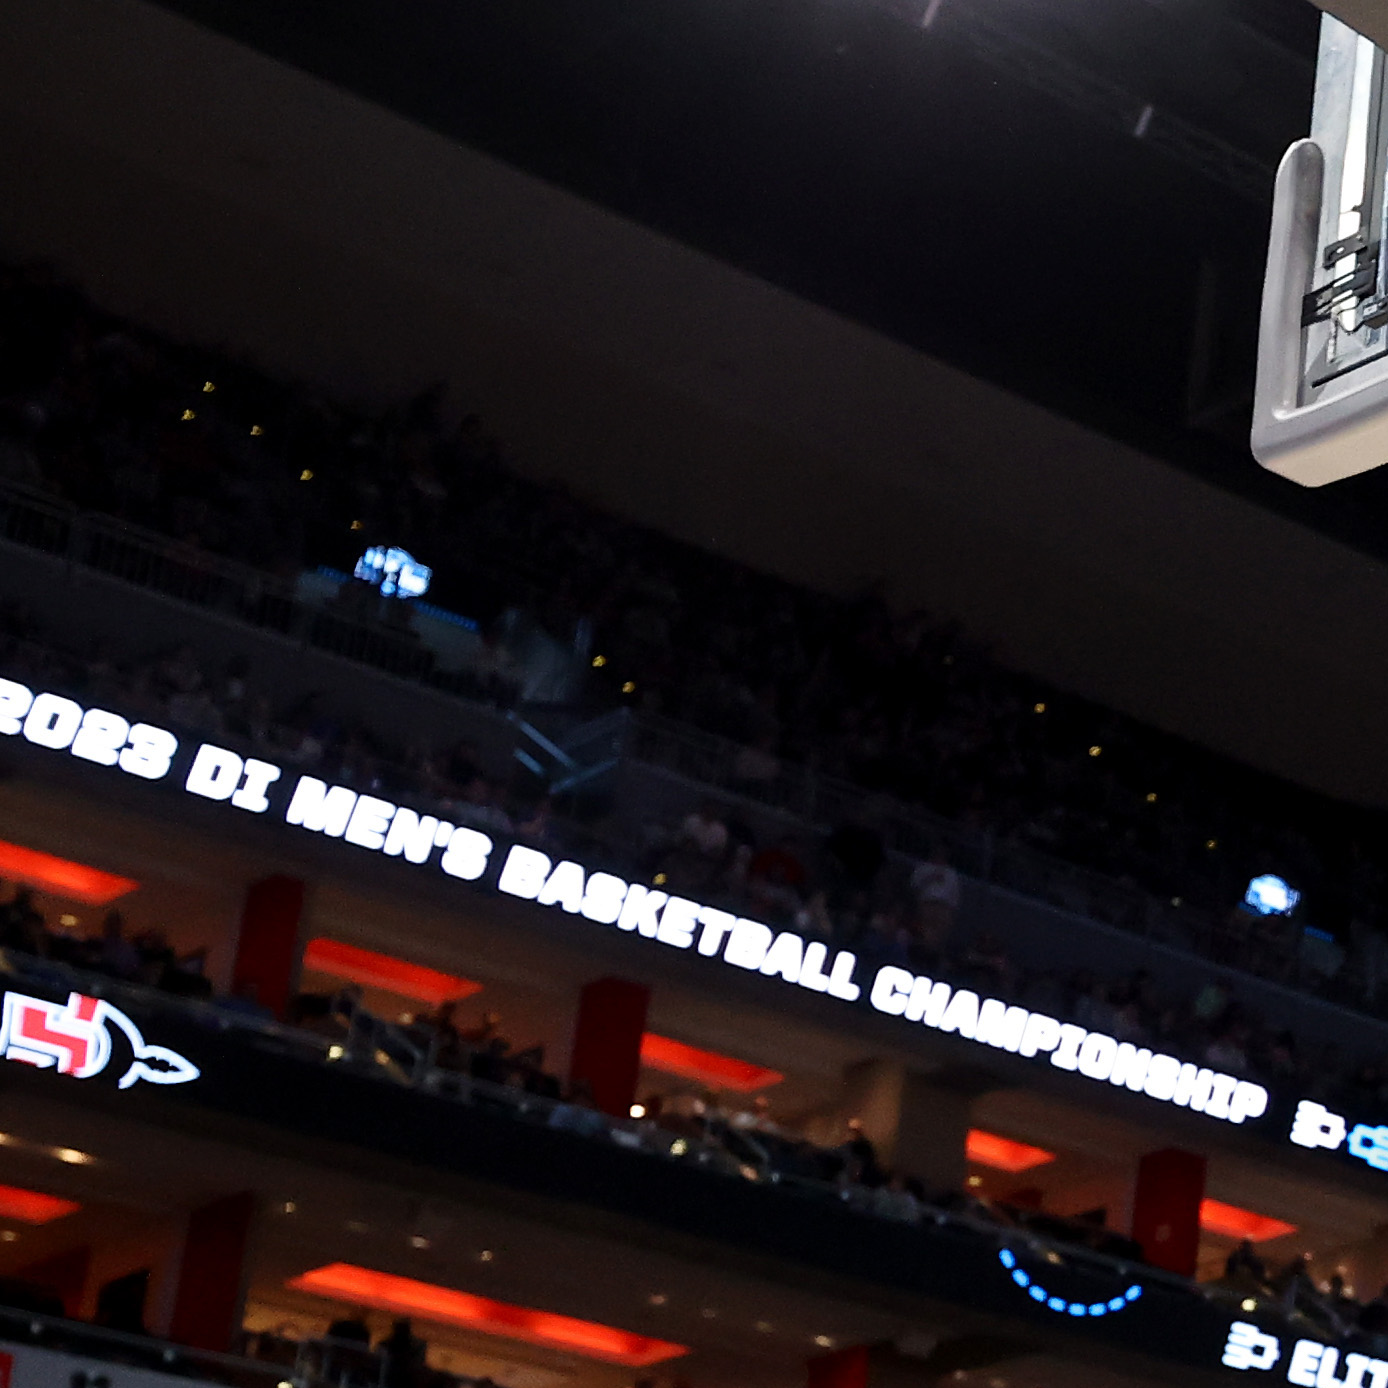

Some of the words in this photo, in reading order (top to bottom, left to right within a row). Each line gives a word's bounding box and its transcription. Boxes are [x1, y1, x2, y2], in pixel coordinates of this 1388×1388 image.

[285, 775, 494, 880] MEN'S
[498, 845, 862, 1001] BASKETBALL
[870, 965, 1269, 1123] CHAMPIONSHIP
